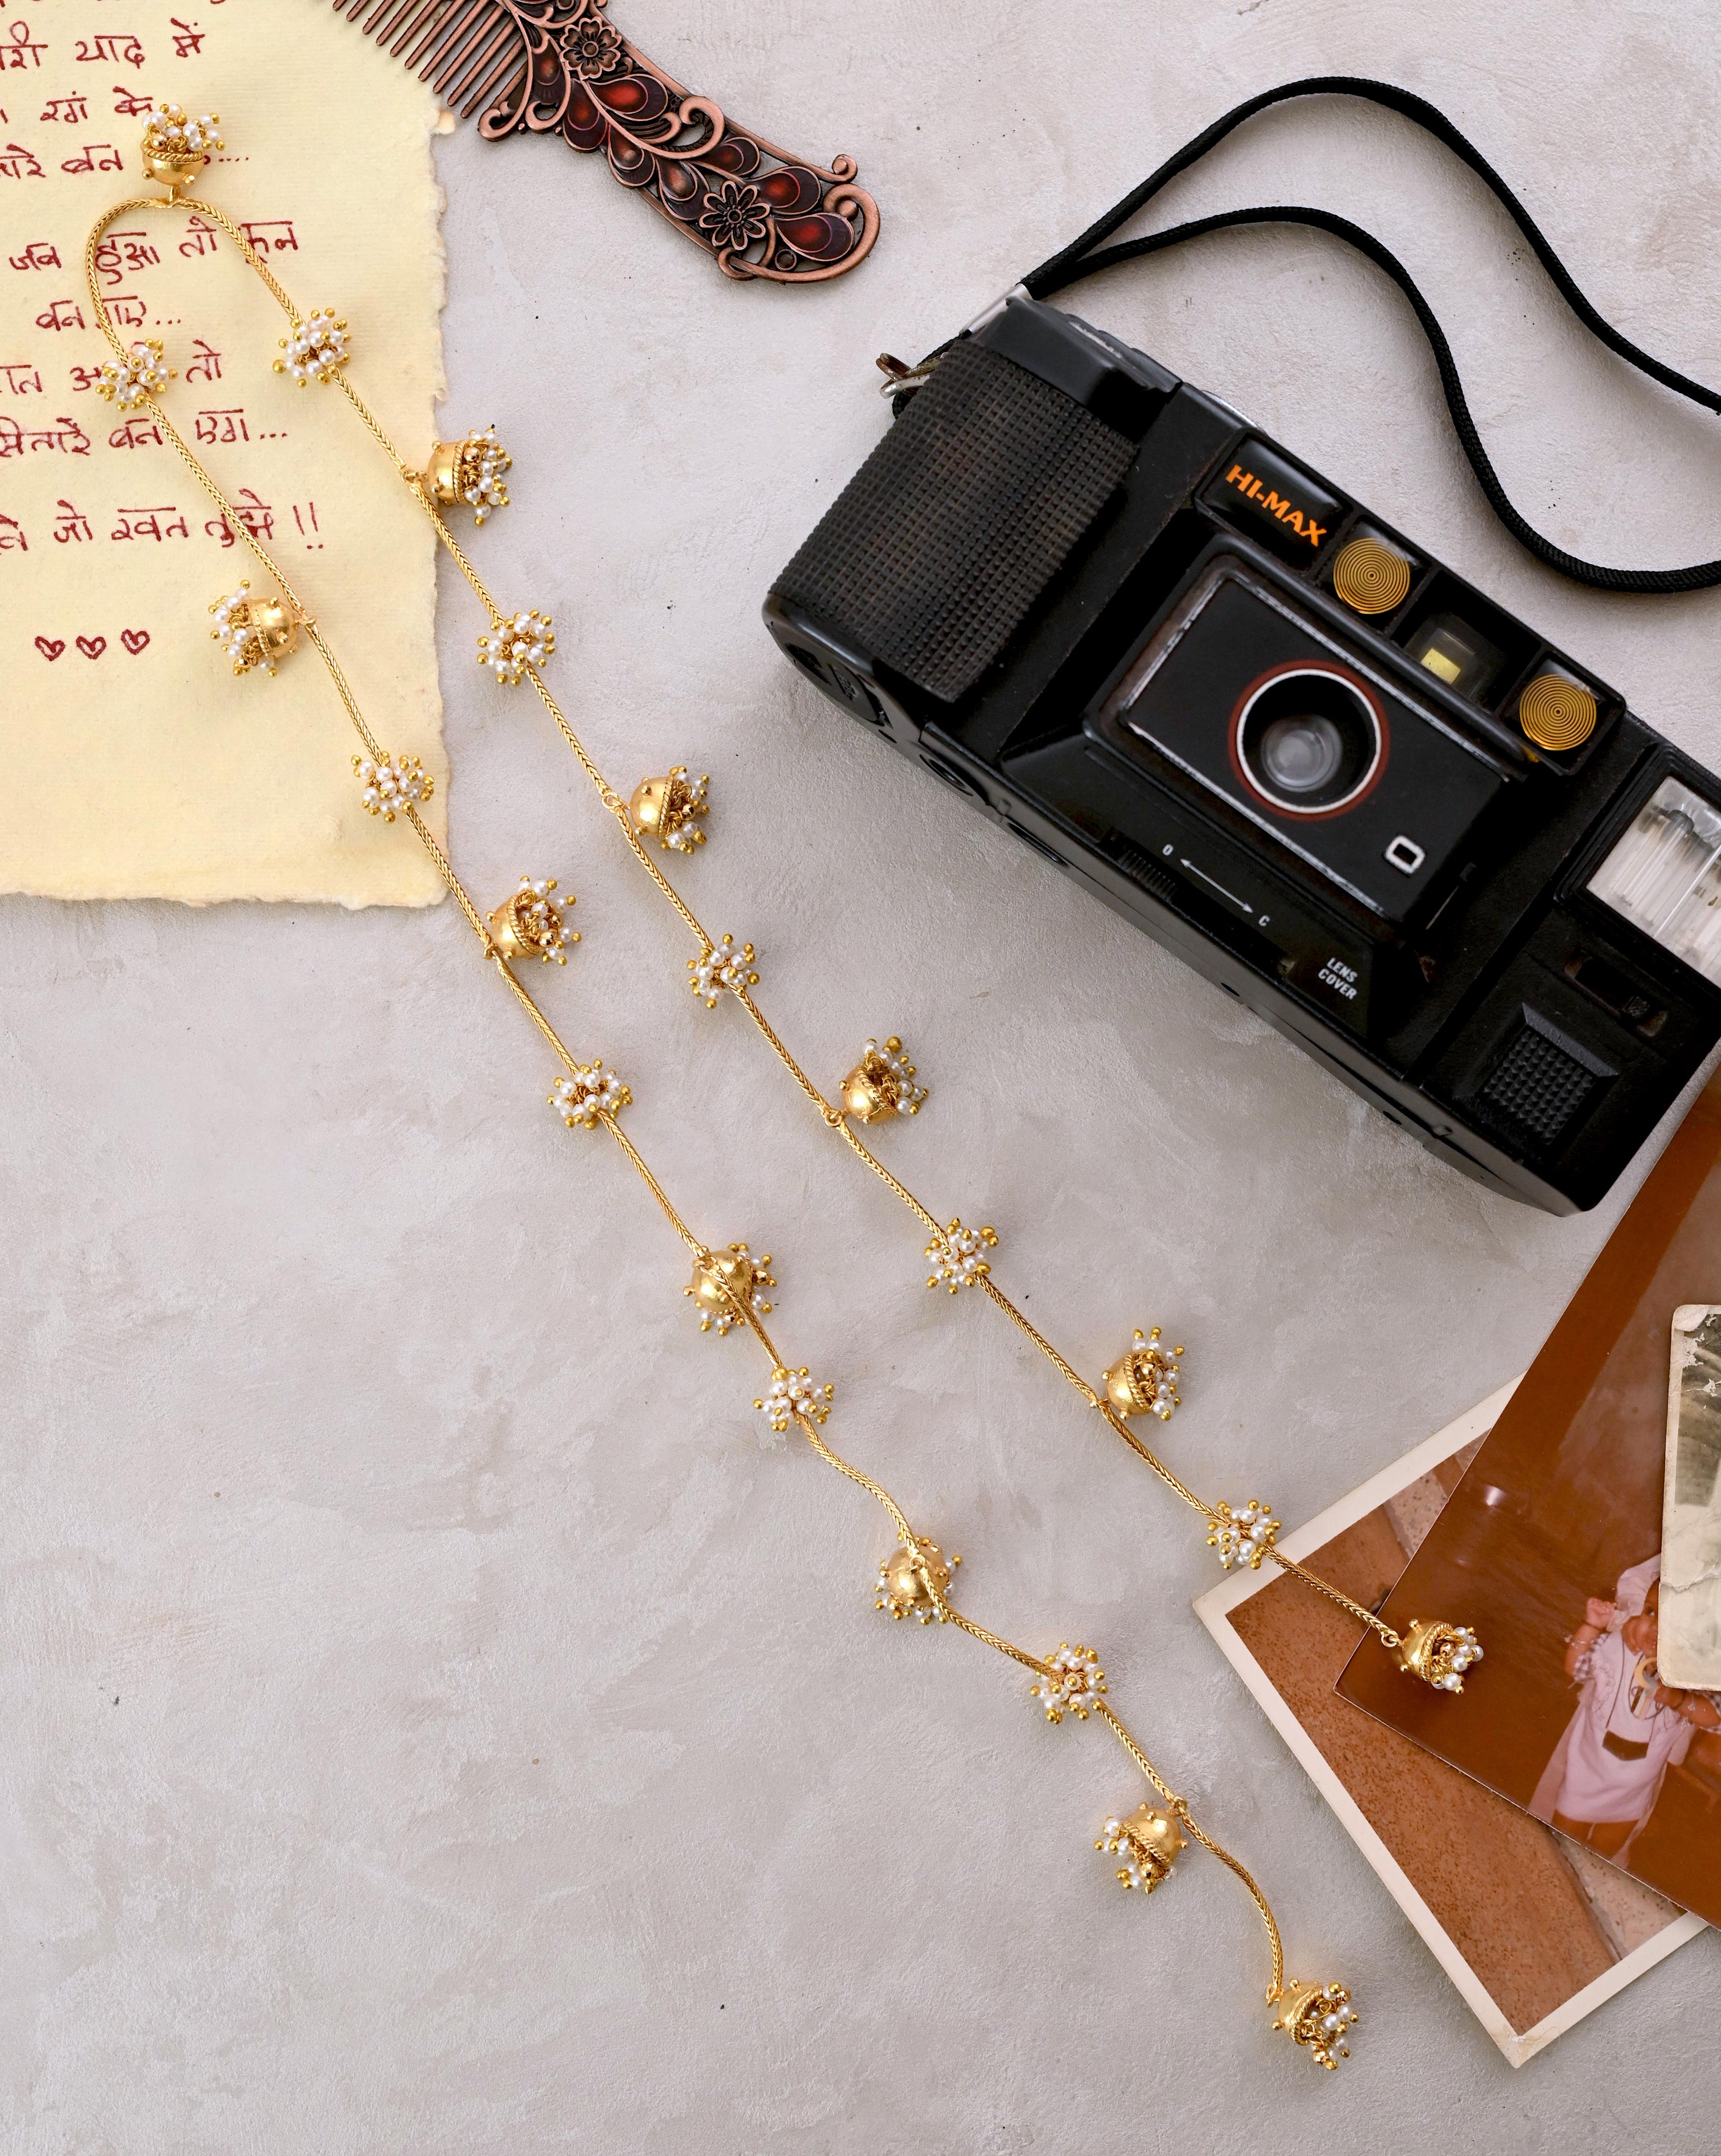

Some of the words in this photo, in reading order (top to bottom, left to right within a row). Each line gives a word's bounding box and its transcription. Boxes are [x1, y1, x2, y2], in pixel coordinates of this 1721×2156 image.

[75, 35, 145, 69] याद
[170, 17, 205, 58] में
[53, 499, 93, 543] जो
[1225, 464, 1327, 547] HI-MAX
[1258, 915, 1271, 927] C
[1318, 968, 1358, 1000] COVER
[1326, 957, 1358, 983] LENS
